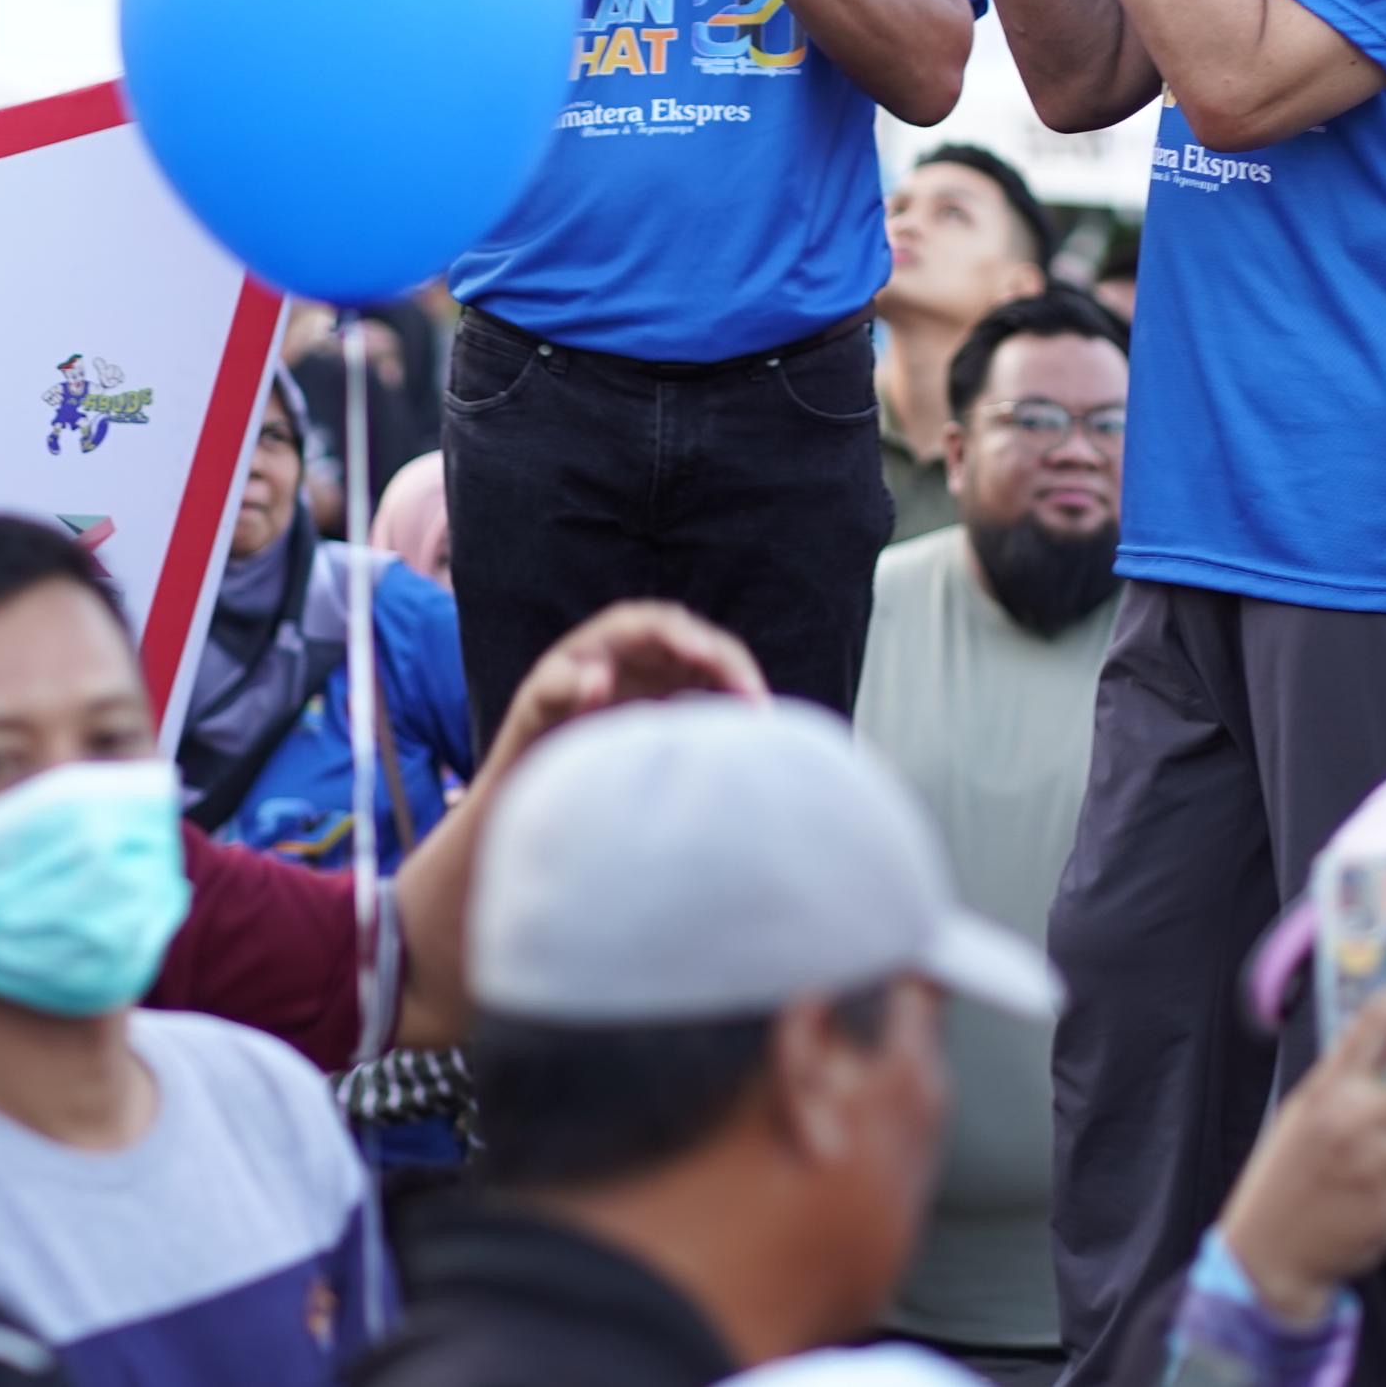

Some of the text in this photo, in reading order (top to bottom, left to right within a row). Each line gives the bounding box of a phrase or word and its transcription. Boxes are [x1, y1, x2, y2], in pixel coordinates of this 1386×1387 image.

[567, 27, 680, 82] HAT
[555, 98, 751, 130] matera Ekspres
[1182, 144, 1273, 184] Ekspres
